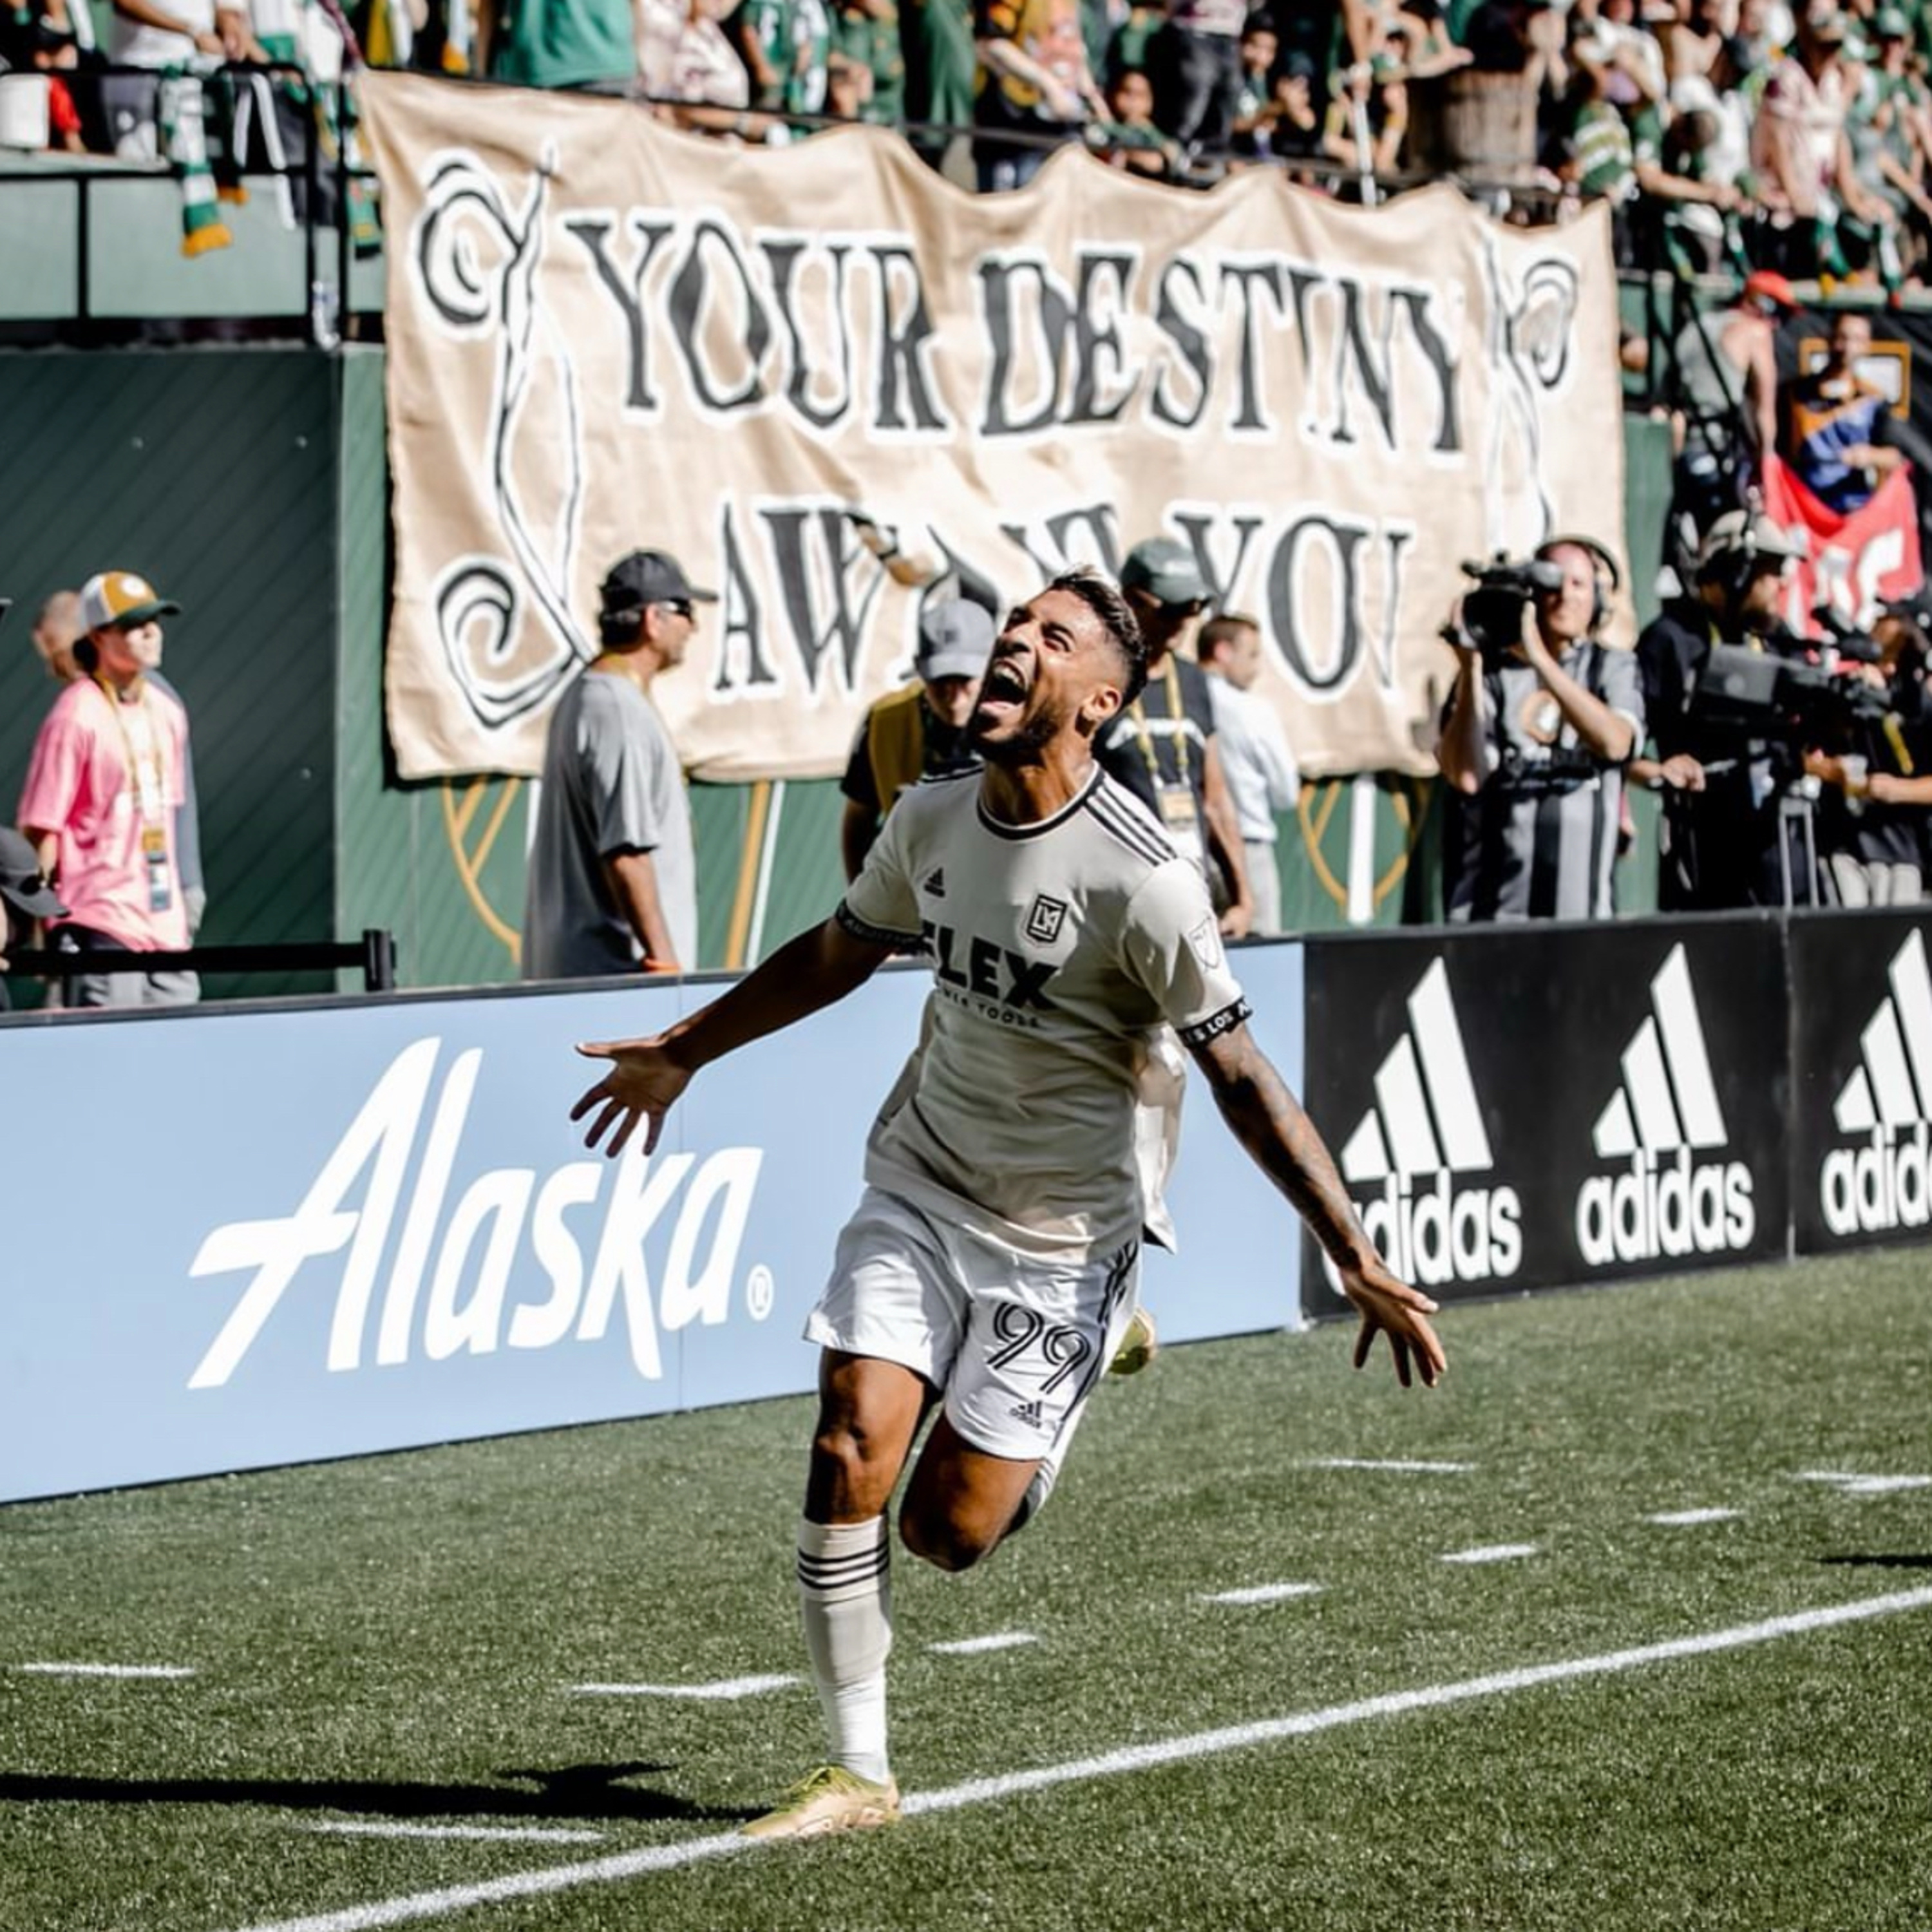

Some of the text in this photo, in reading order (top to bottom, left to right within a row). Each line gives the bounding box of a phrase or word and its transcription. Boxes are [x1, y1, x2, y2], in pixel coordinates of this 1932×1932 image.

[564, 220, 1462, 452] YOUR DESTINY
[1173, 513, 1410, 689] YOU
[1206, 1010, 1234, 1034] LOS
[1577, 1144, 1756, 1265] adidas
[1819, 1118, 1932, 1236] adid
[987, 1302, 1091, 1395] 99
